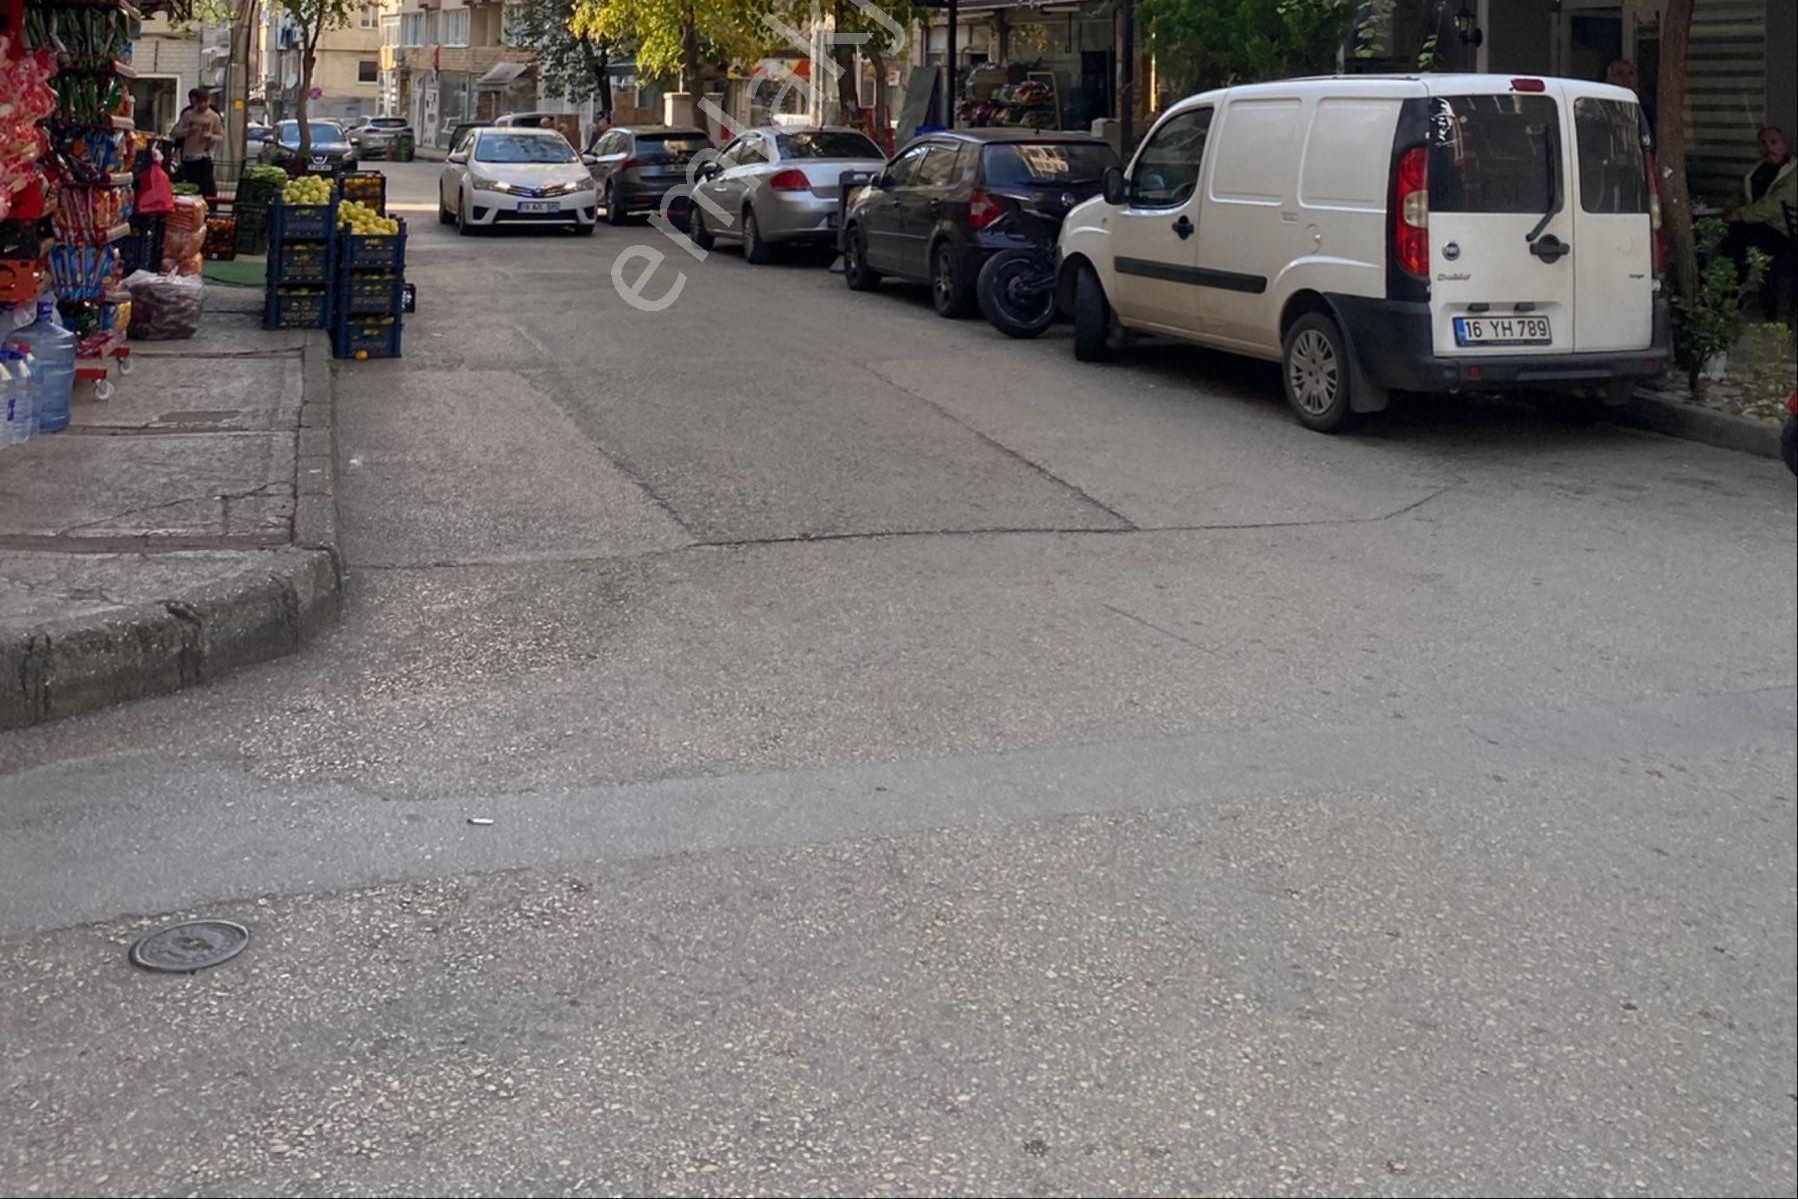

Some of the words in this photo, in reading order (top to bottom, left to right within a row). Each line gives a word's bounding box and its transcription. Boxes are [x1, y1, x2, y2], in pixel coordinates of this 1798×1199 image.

[1465, 321, 1483, 338] 16
[1490, 320, 1513, 337] YH
[1517, 320, 1547, 337] 789
